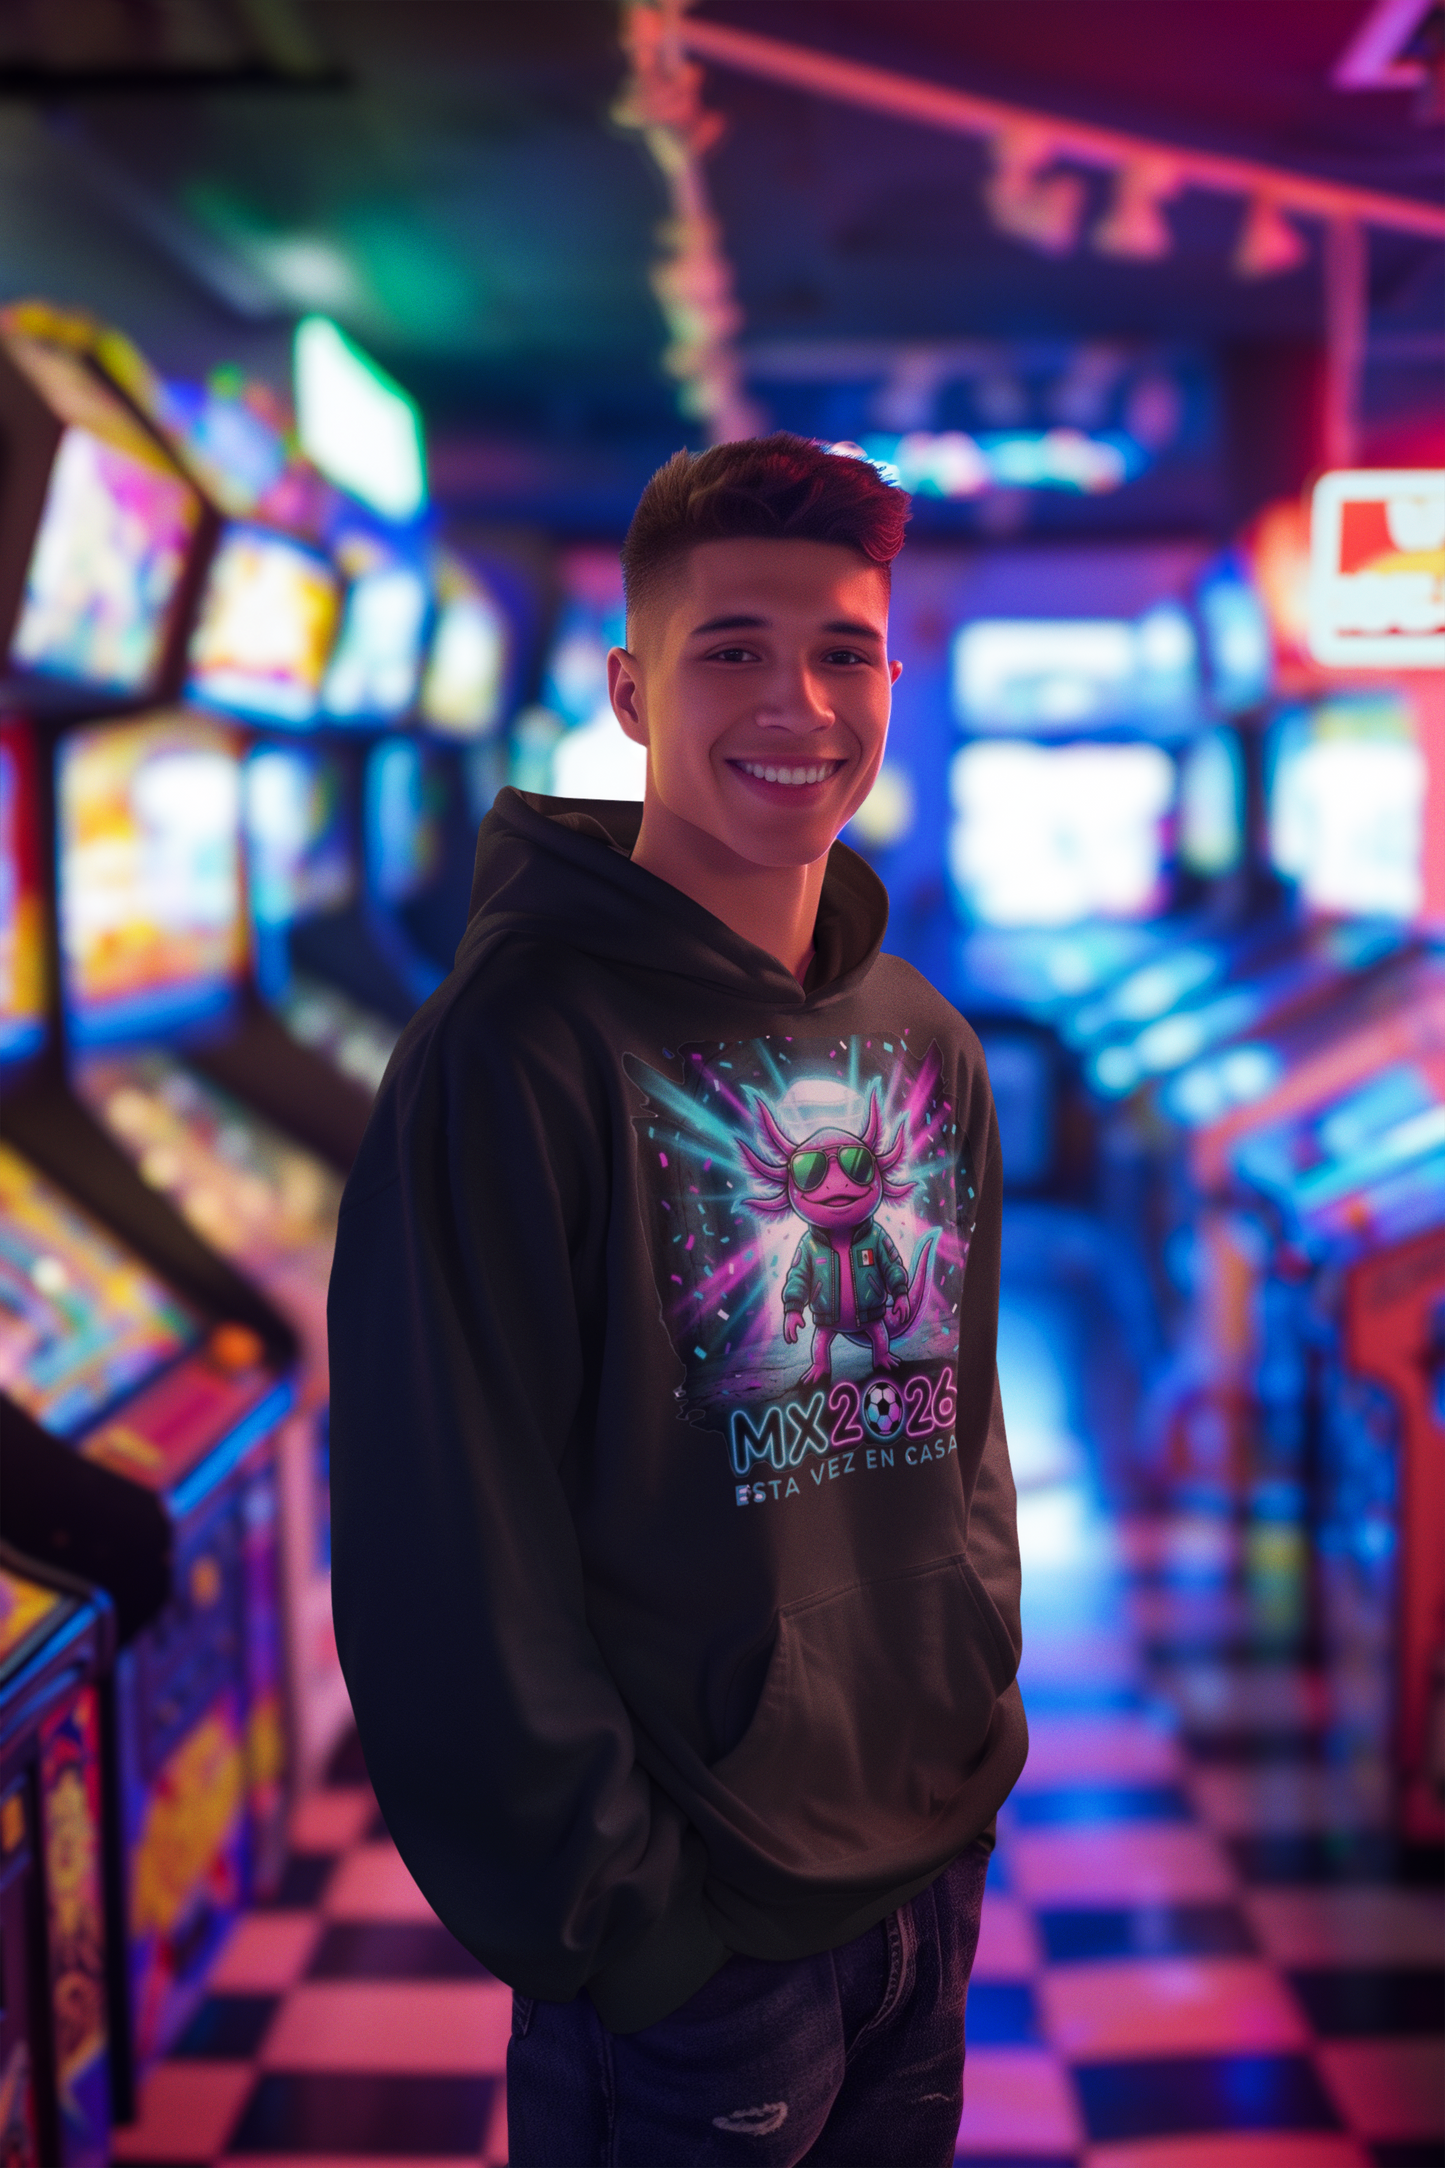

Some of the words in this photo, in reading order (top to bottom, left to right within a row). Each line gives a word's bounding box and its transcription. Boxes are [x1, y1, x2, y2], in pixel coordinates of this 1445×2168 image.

[735, 1477, 800, 1506] ESTA
[811, 1453, 855, 1485] VEZ
[866, 1449, 894, 1469] EN
[905, 1434, 957, 1465] CASA
